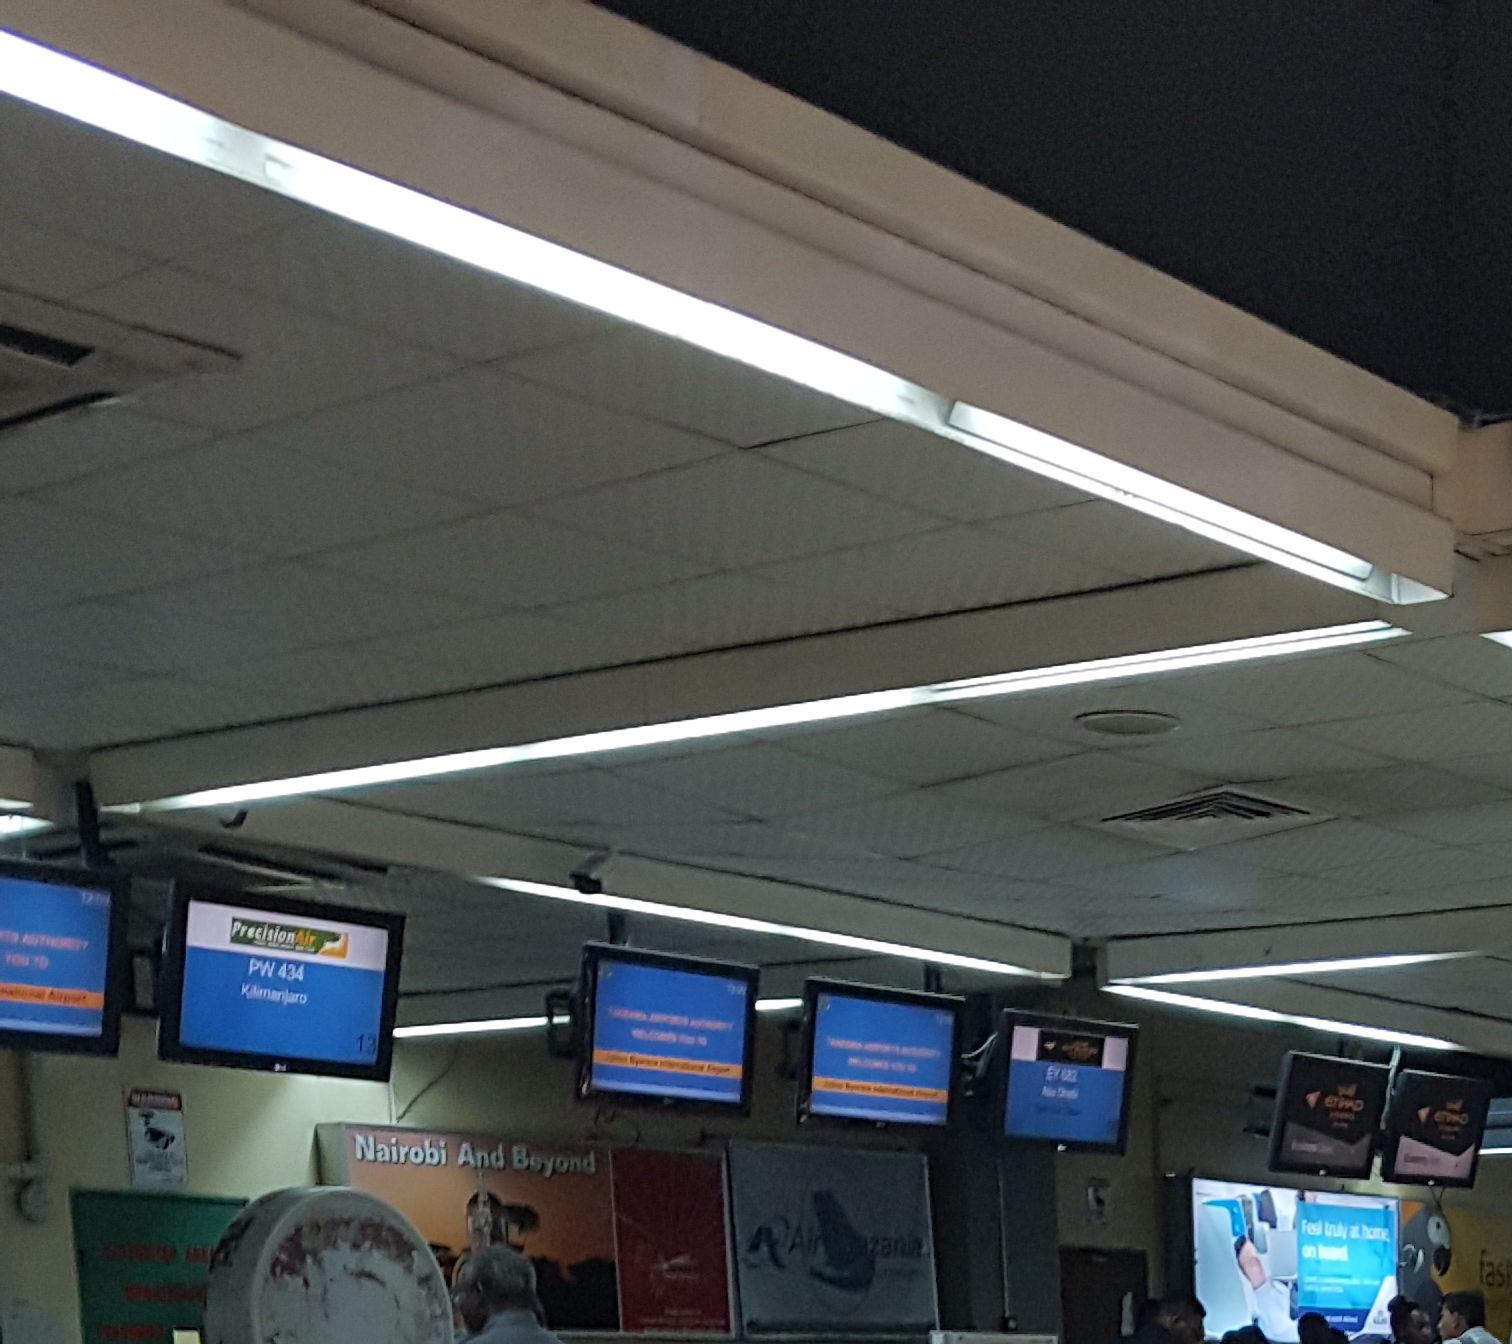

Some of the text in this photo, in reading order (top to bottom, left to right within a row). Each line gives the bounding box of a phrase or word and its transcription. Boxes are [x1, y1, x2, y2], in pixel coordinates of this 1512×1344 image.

[248, 958, 305, 982] PW 434
[240, 983, 308, 1006] Kilimanjaro
[354, 1134, 597, 1179] Nairobi And Beyond
